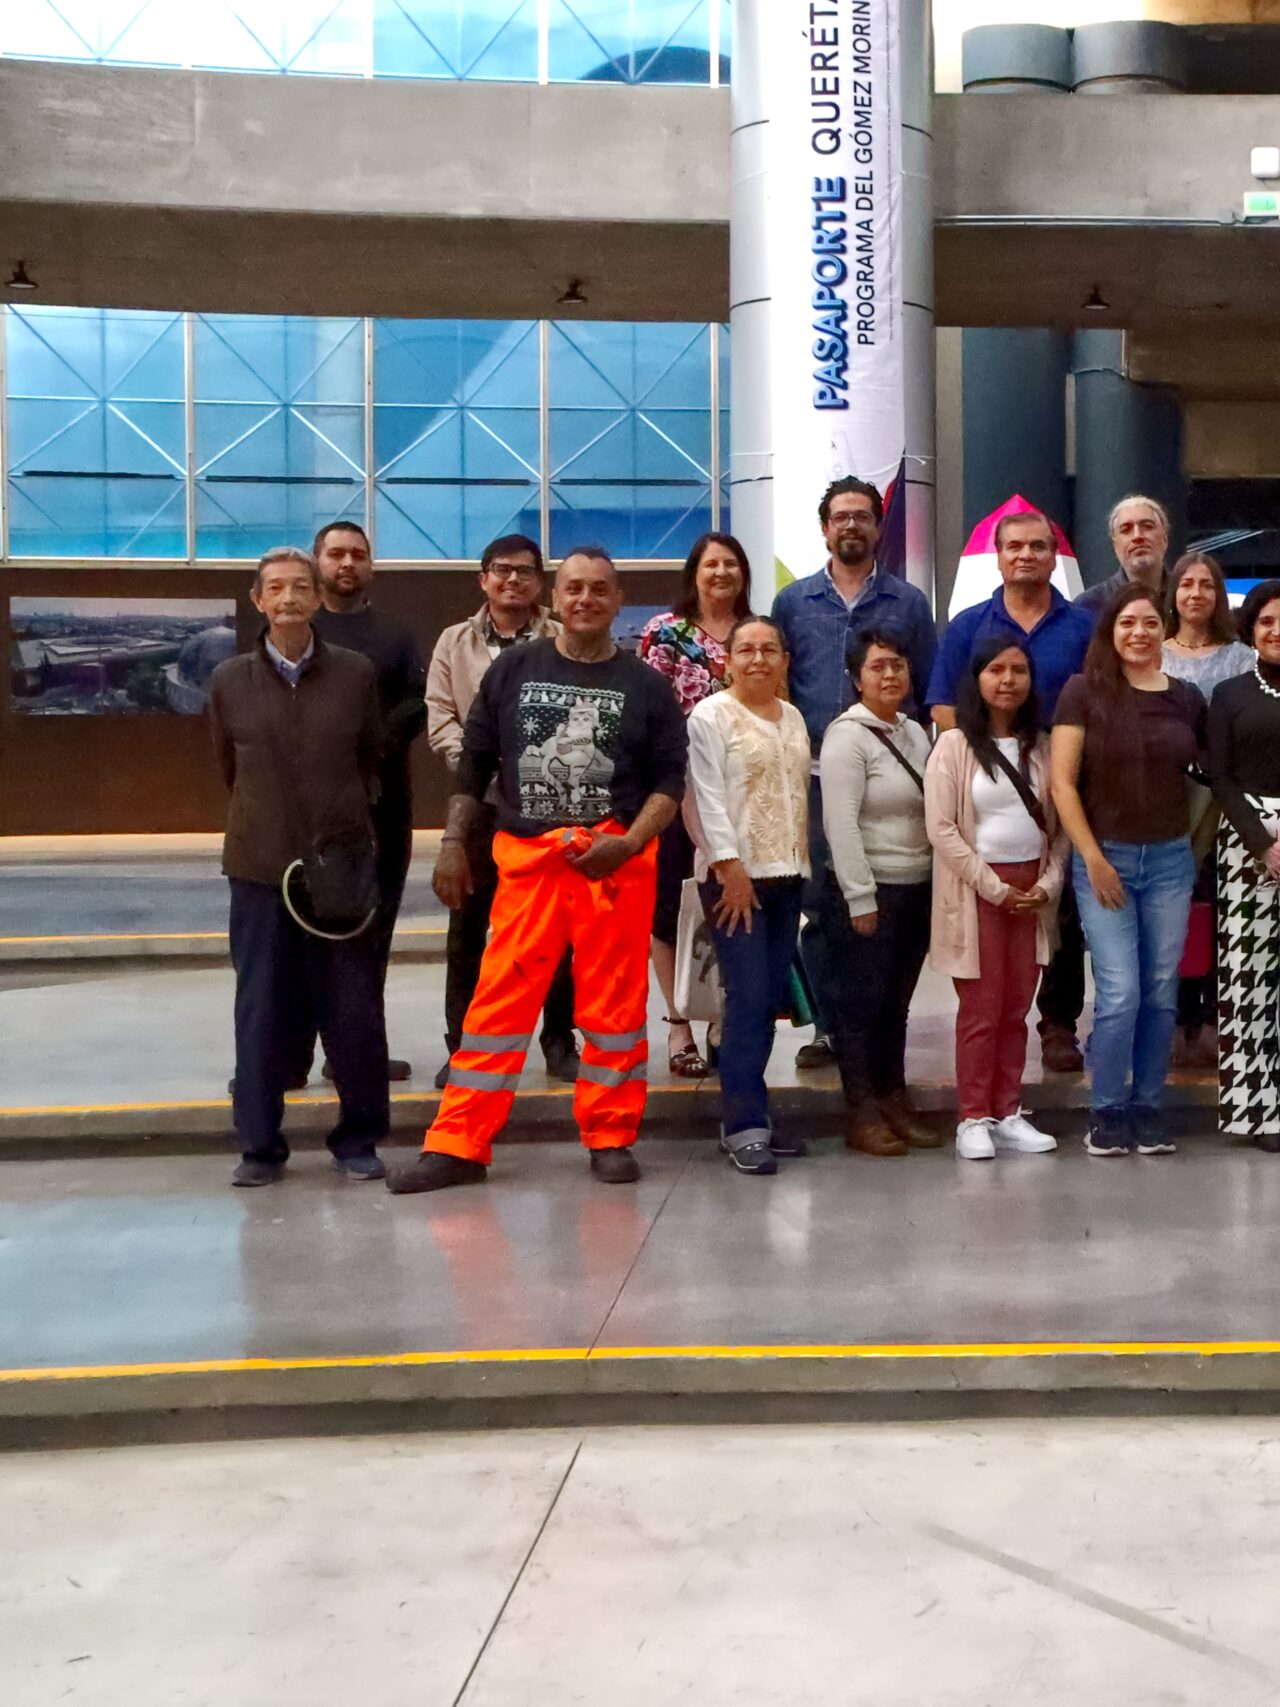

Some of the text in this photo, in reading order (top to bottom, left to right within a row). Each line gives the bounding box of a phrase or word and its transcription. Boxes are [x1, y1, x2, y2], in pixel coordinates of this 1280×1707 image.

[849, 80, 873, 164] GÓMEZ
[855, 169, 873, 212] DEL
[812, 177, 849, 410] PASAPORTE
[856, 218, 875, 346] PROGRAMA
